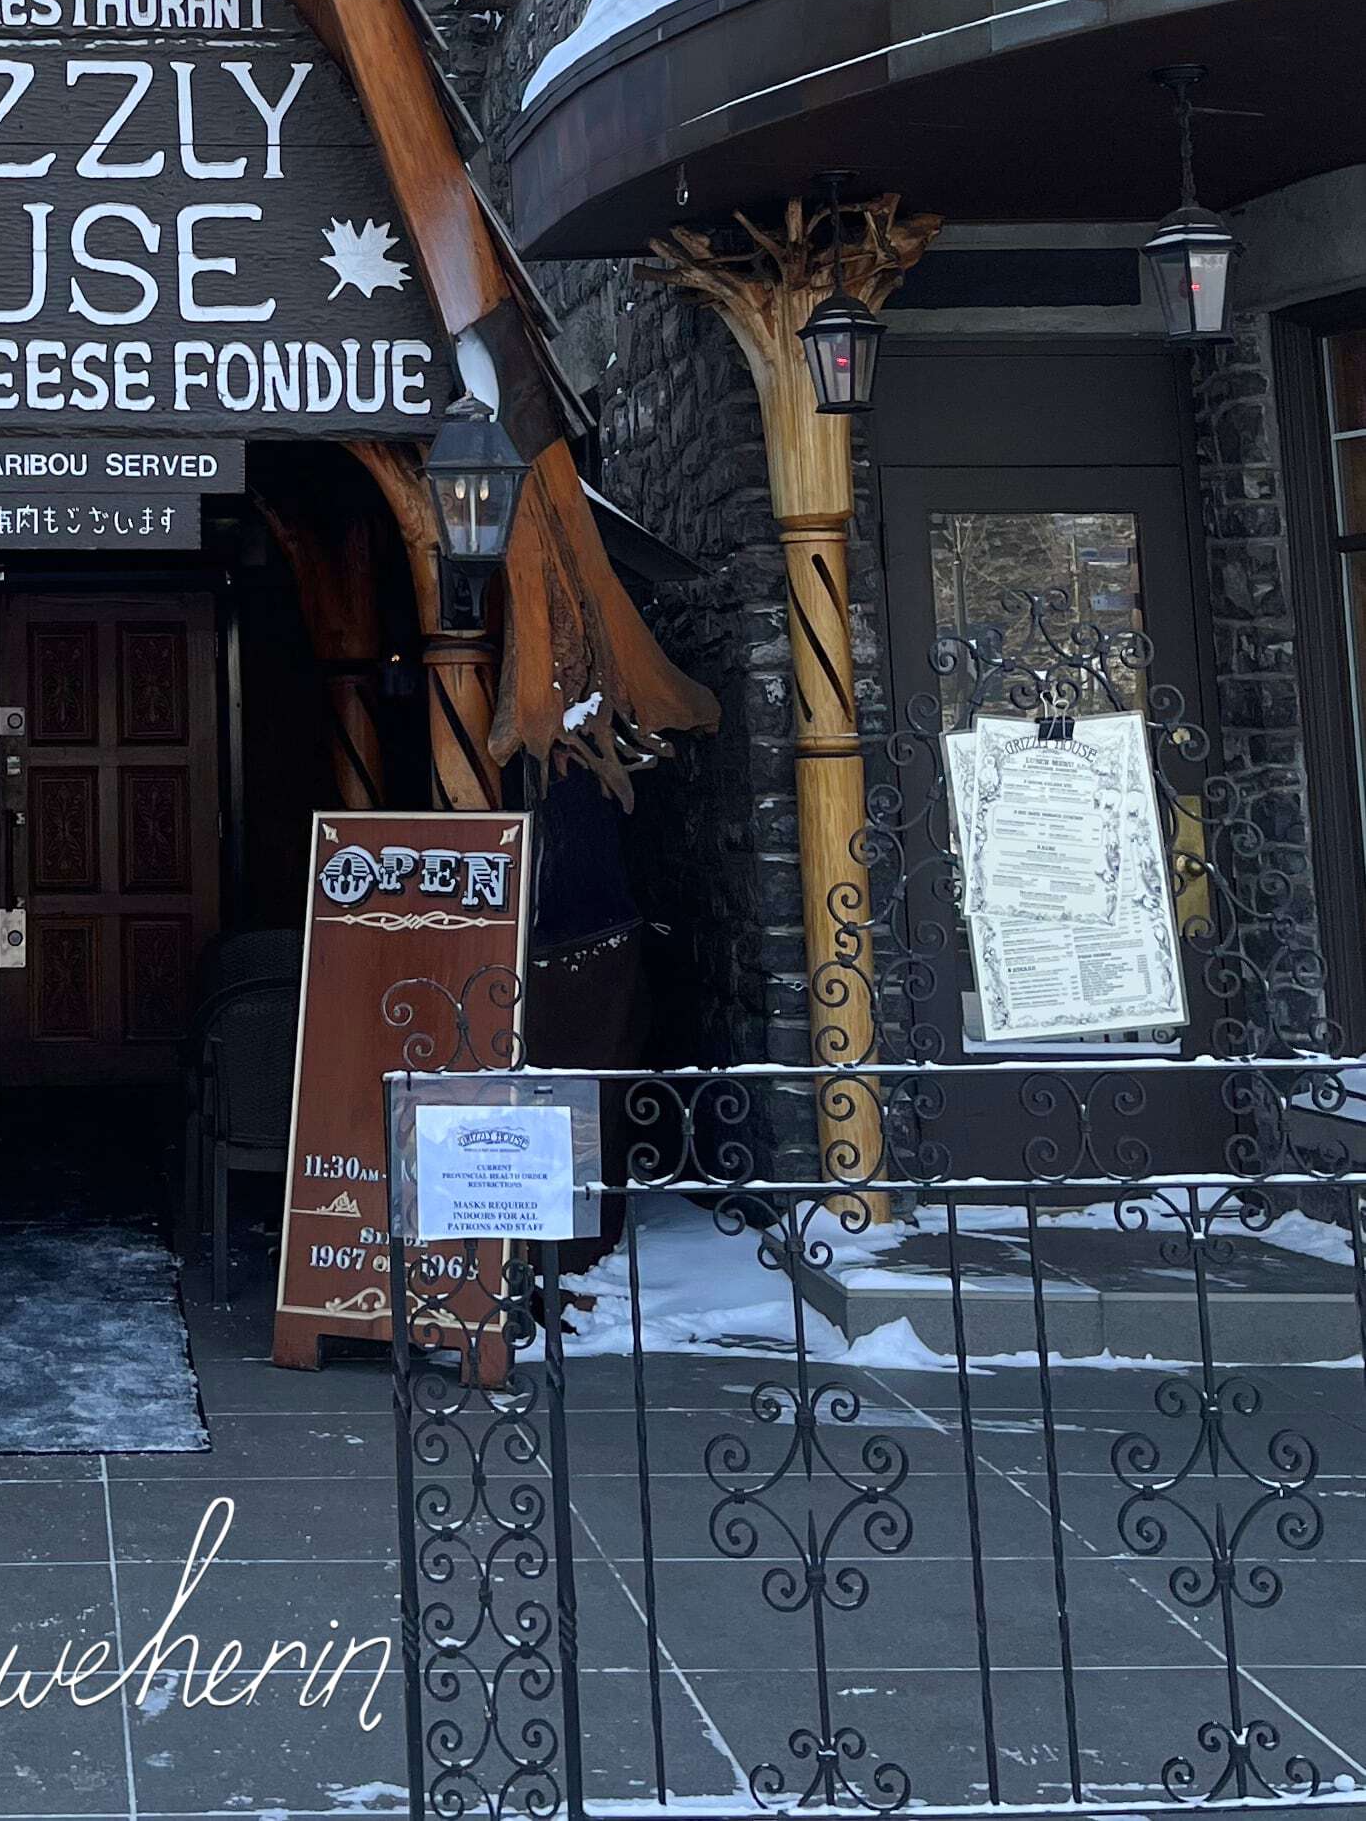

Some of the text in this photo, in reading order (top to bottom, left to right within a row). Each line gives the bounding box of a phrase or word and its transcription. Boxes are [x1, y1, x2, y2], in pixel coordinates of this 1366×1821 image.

[173, 339, 433, 415] FONDUE
[105, 453, 218, 477] SERVED
[318, 850, 512, 908] OPEN
[453, 1201, 538, 1210] MASKS REQUIRED
[453, 1212, 538, 1220] INDOORS FOR ALL
[516, 1223, 544, 1231] STAFF
[310, 1244, 367, 1270] 1967
